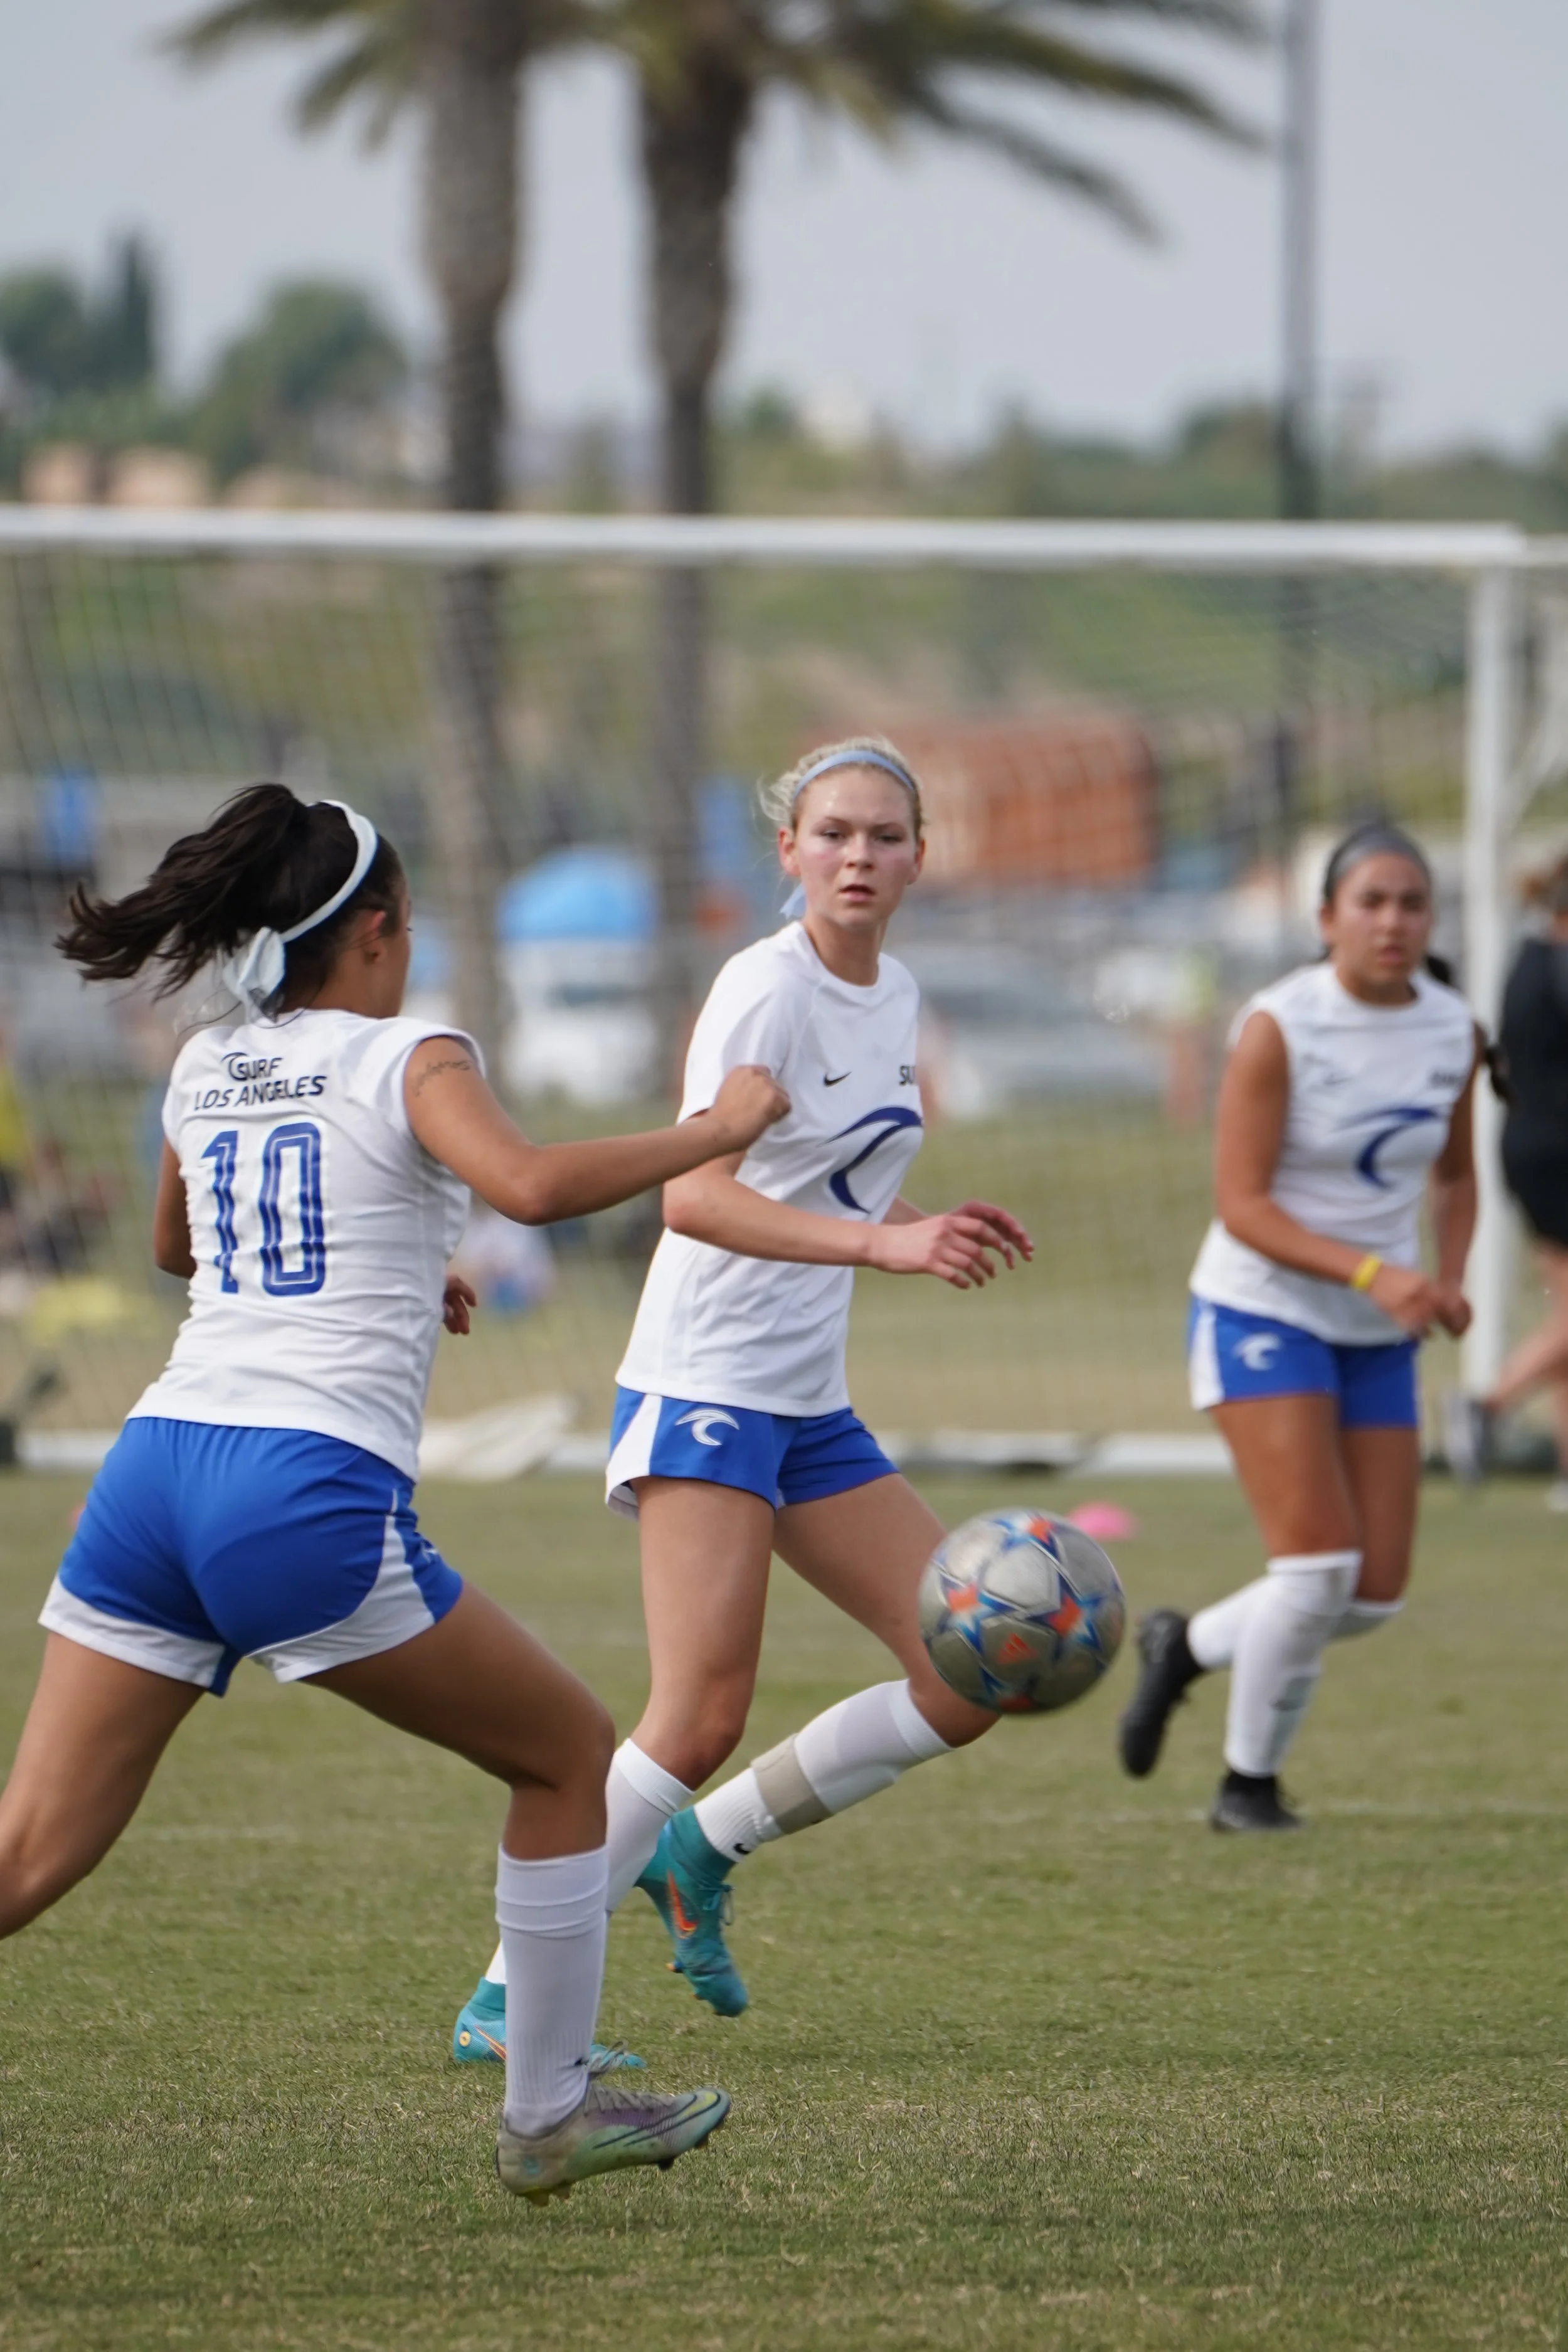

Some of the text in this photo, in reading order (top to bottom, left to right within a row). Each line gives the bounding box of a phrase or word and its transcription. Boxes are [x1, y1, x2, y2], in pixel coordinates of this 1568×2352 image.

[236, 1057, 283, 1081] SURF
[193, 1075, 328, 1111] LOS ANGELES
[201, 1121, 327, 1297] 10
